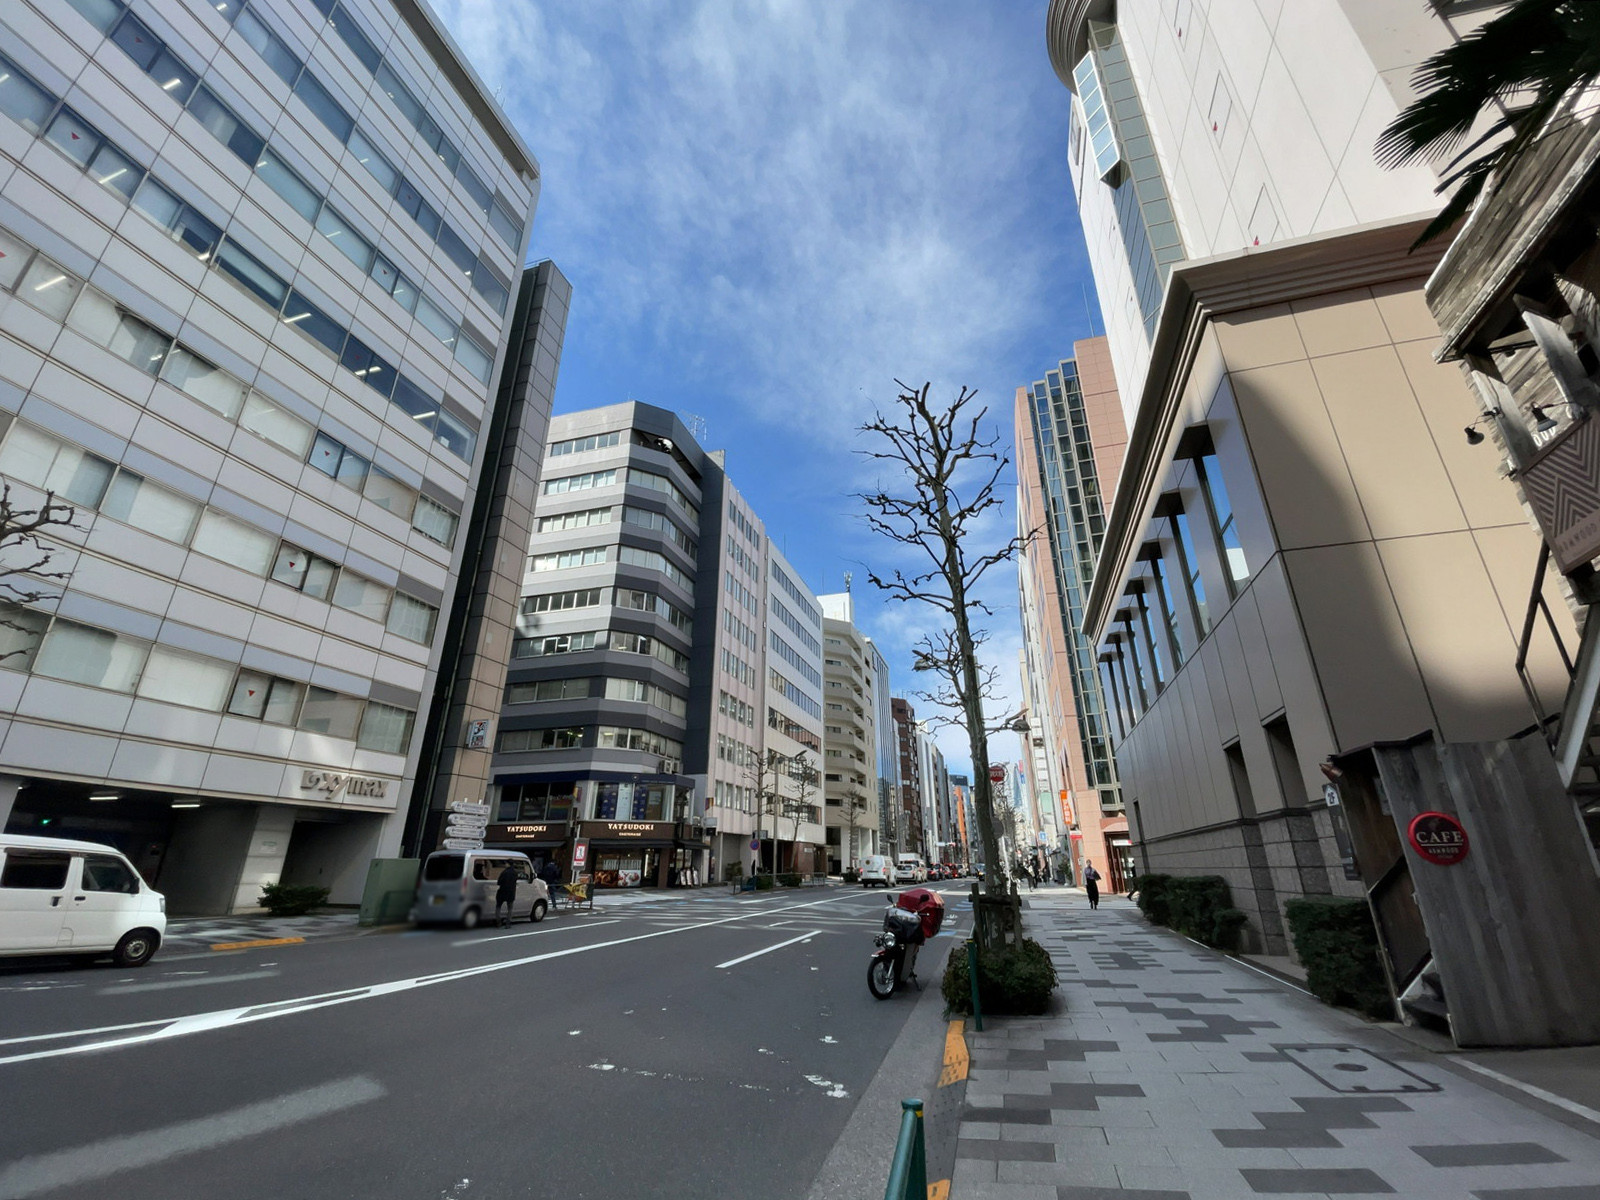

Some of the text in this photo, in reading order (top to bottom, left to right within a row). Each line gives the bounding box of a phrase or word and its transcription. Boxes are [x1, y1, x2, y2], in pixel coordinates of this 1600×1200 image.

[506, 825, 547, 833] YATSUDOKI
[607, 823, 655, 831] YATSUDOKI
[1415, 830, 1465, 843] CAFE
